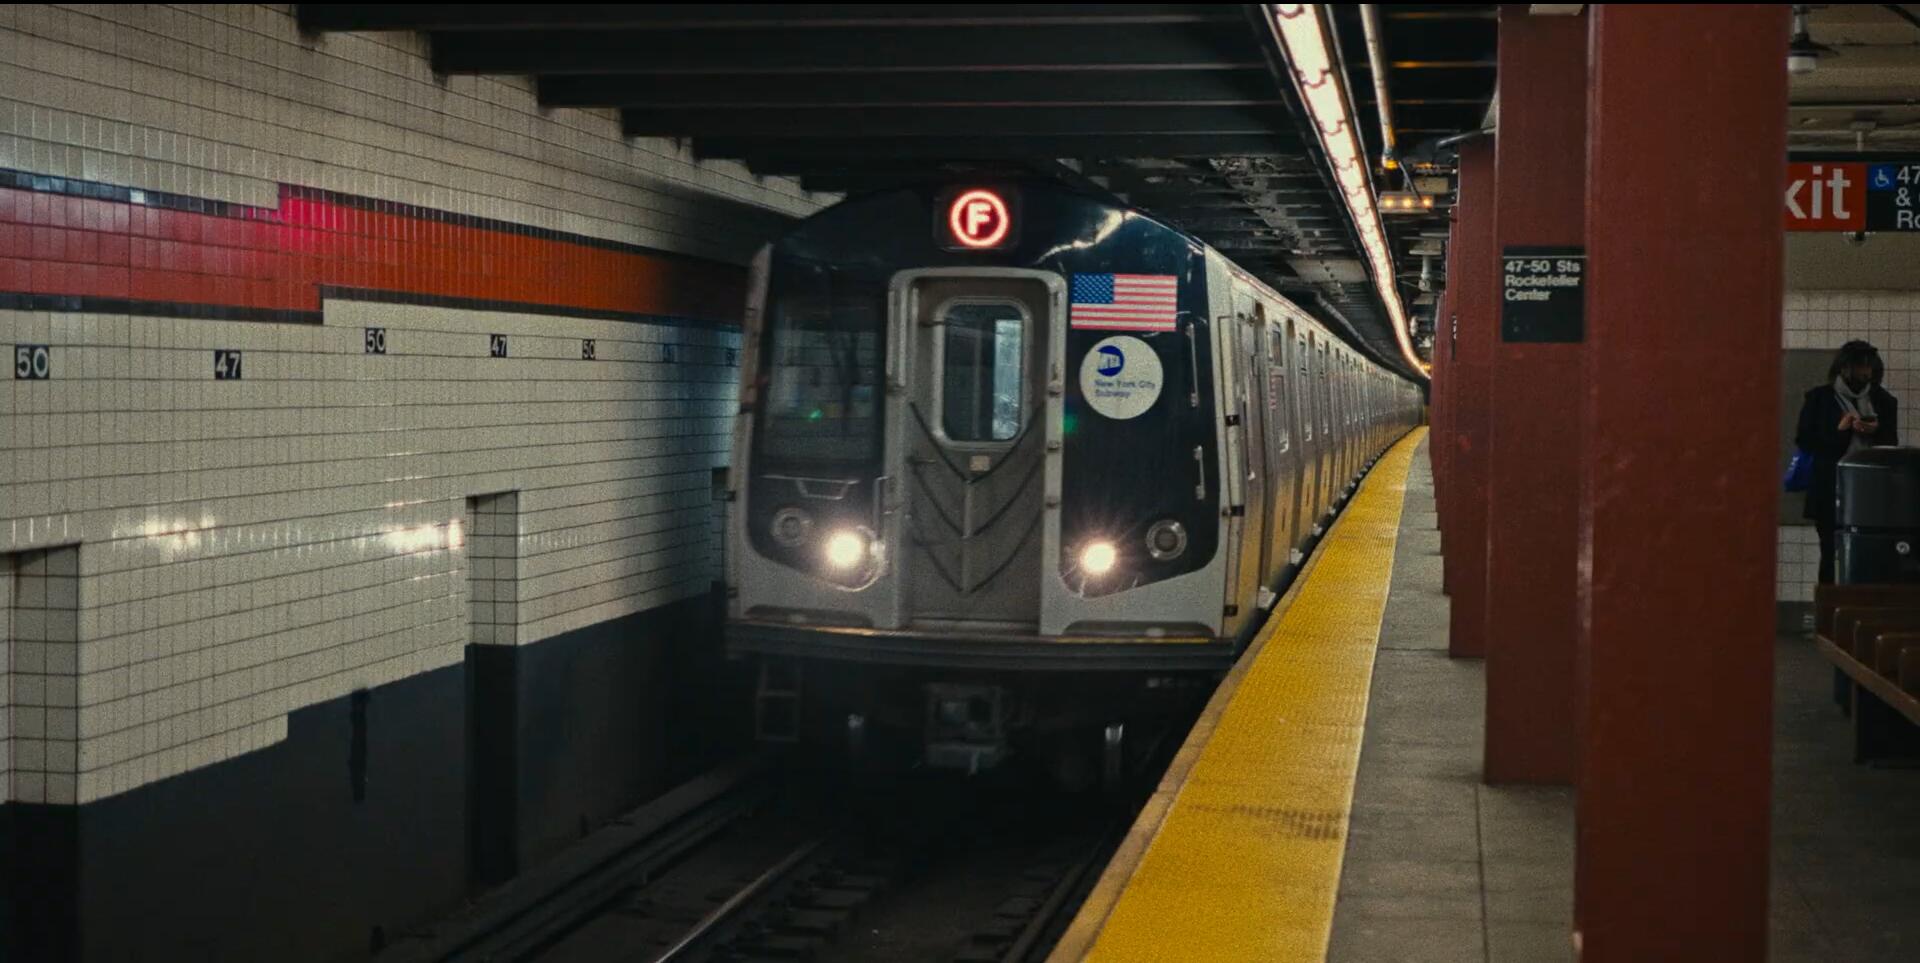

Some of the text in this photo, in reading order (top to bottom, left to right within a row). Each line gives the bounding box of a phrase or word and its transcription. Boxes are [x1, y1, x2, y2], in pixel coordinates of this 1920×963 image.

[1785, 165, 1851, 219] xit
[1895, 187, 1911, 207] &
[967, 203, 991, 235] F
[1505, 260, 1580, 273] 47-50 Sts
[1505, 274, 1580, 287] Rockefeller
[1505, 288, 1550, 301] Center
[367, 329, 385, 352] 50
[491, 335, 506, 356] 47
[17, 347, 49, 378] 50
[216, 351, 240, 378] 47
